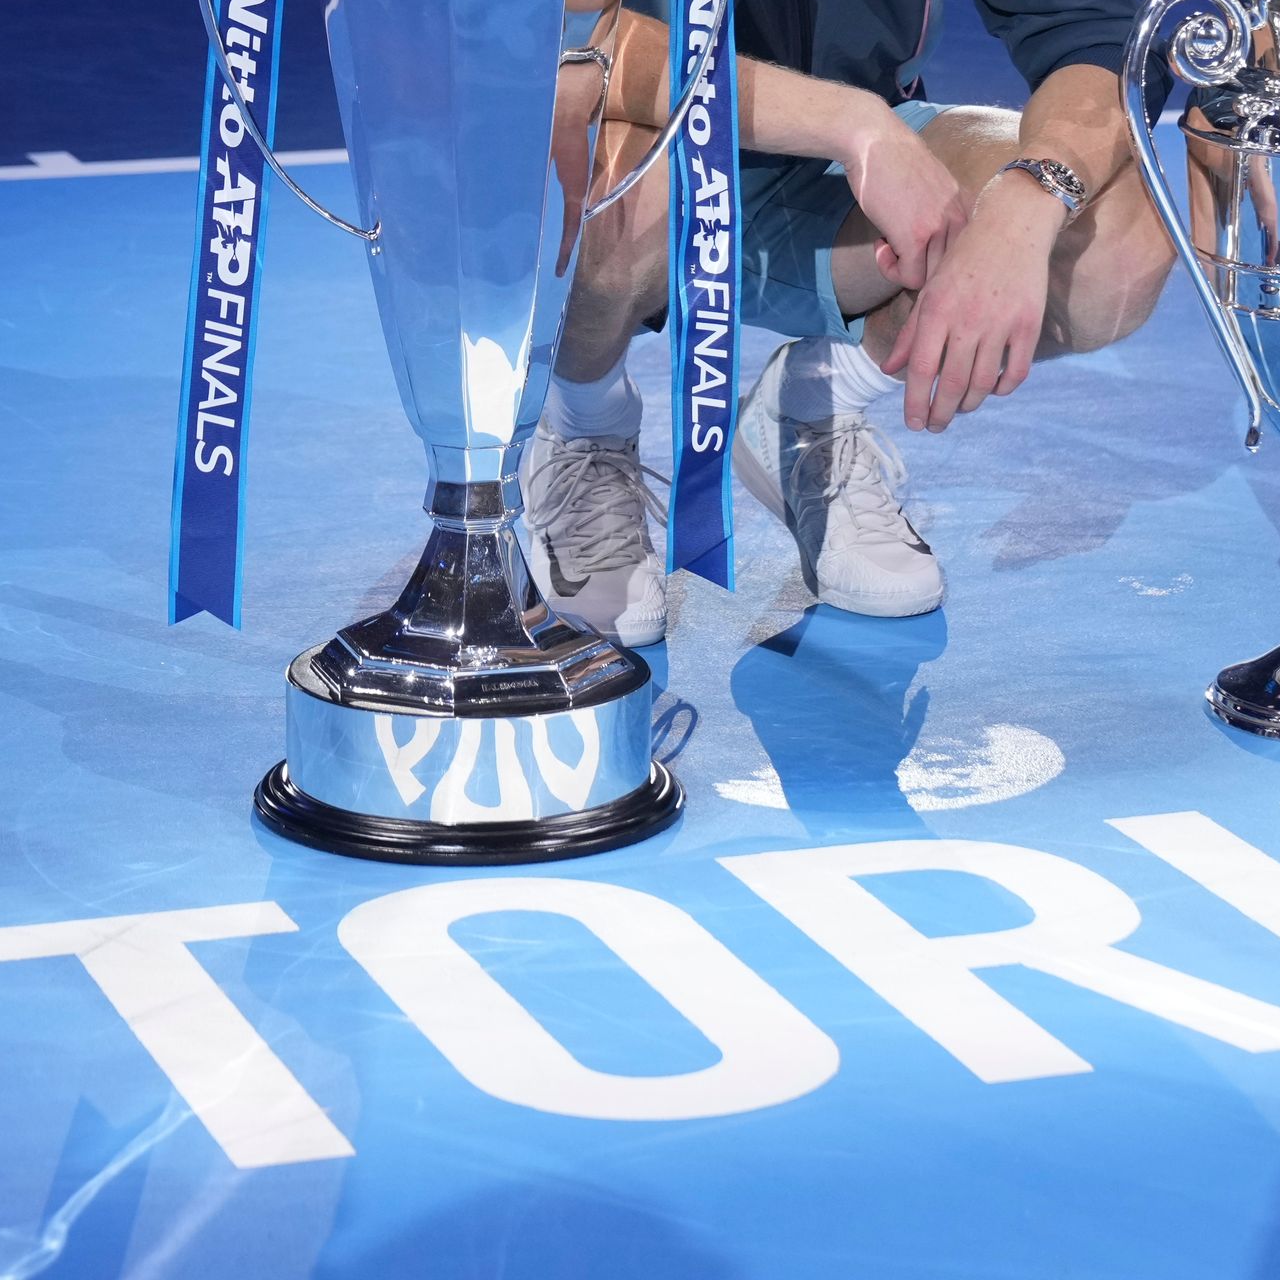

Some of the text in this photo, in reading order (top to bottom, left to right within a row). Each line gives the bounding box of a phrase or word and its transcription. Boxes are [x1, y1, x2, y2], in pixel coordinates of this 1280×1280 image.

[210, 151, 256, 287] ATP
[691, 151, 730, 274] ATP
[194, 288, 246, 477] FINALS
[691, 278, 730, 452] FINALS
